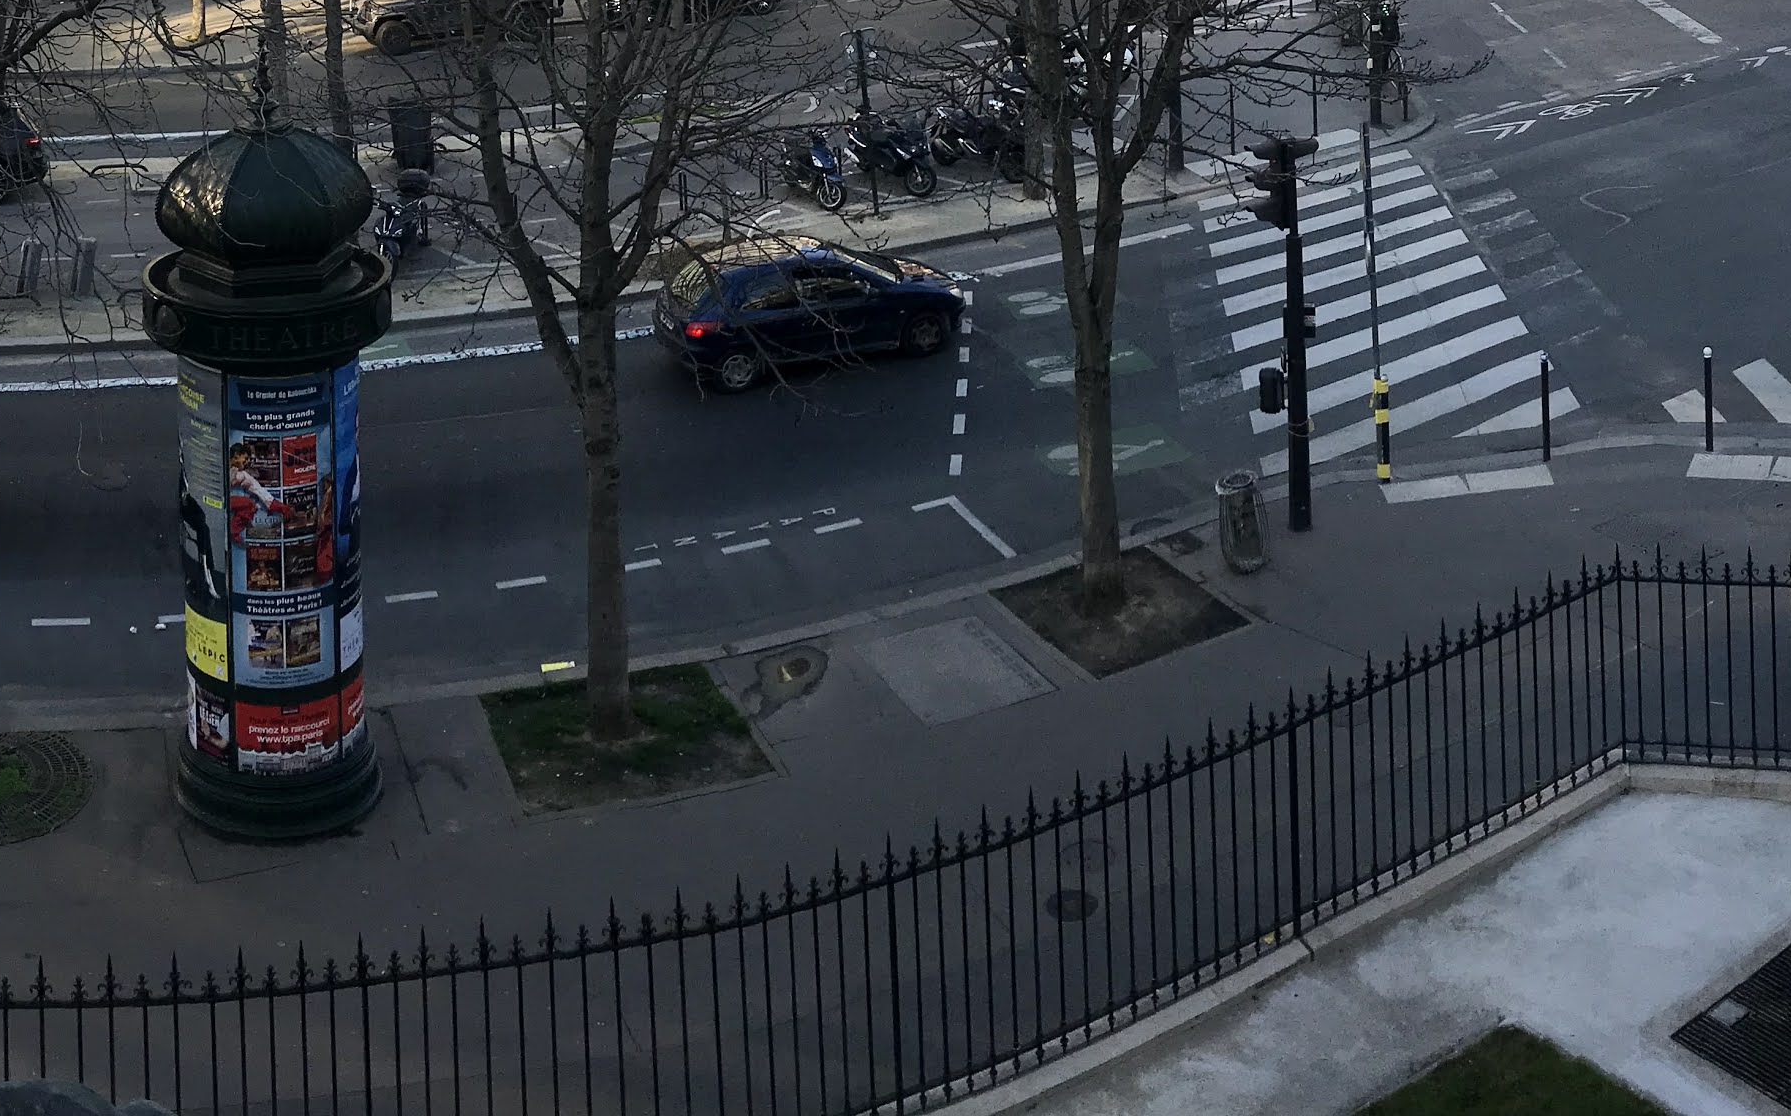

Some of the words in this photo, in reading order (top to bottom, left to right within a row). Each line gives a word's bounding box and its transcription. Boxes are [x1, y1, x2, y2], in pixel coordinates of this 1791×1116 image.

[246, 412, 262, 420] Les
[264, 413, 283, 422] plus
[286, 409, 315, 421] grands
[634, 507, 836, 551] PAYANT
[276, 597, 294, 606] plus
[297, 592, 322, 602] beaux
[297, 601, 318, 611] Paris
[248, 725, 279, 734] prenez
[280, 726, 289, 734] le
[290, 717, 330, 733] raccourci
